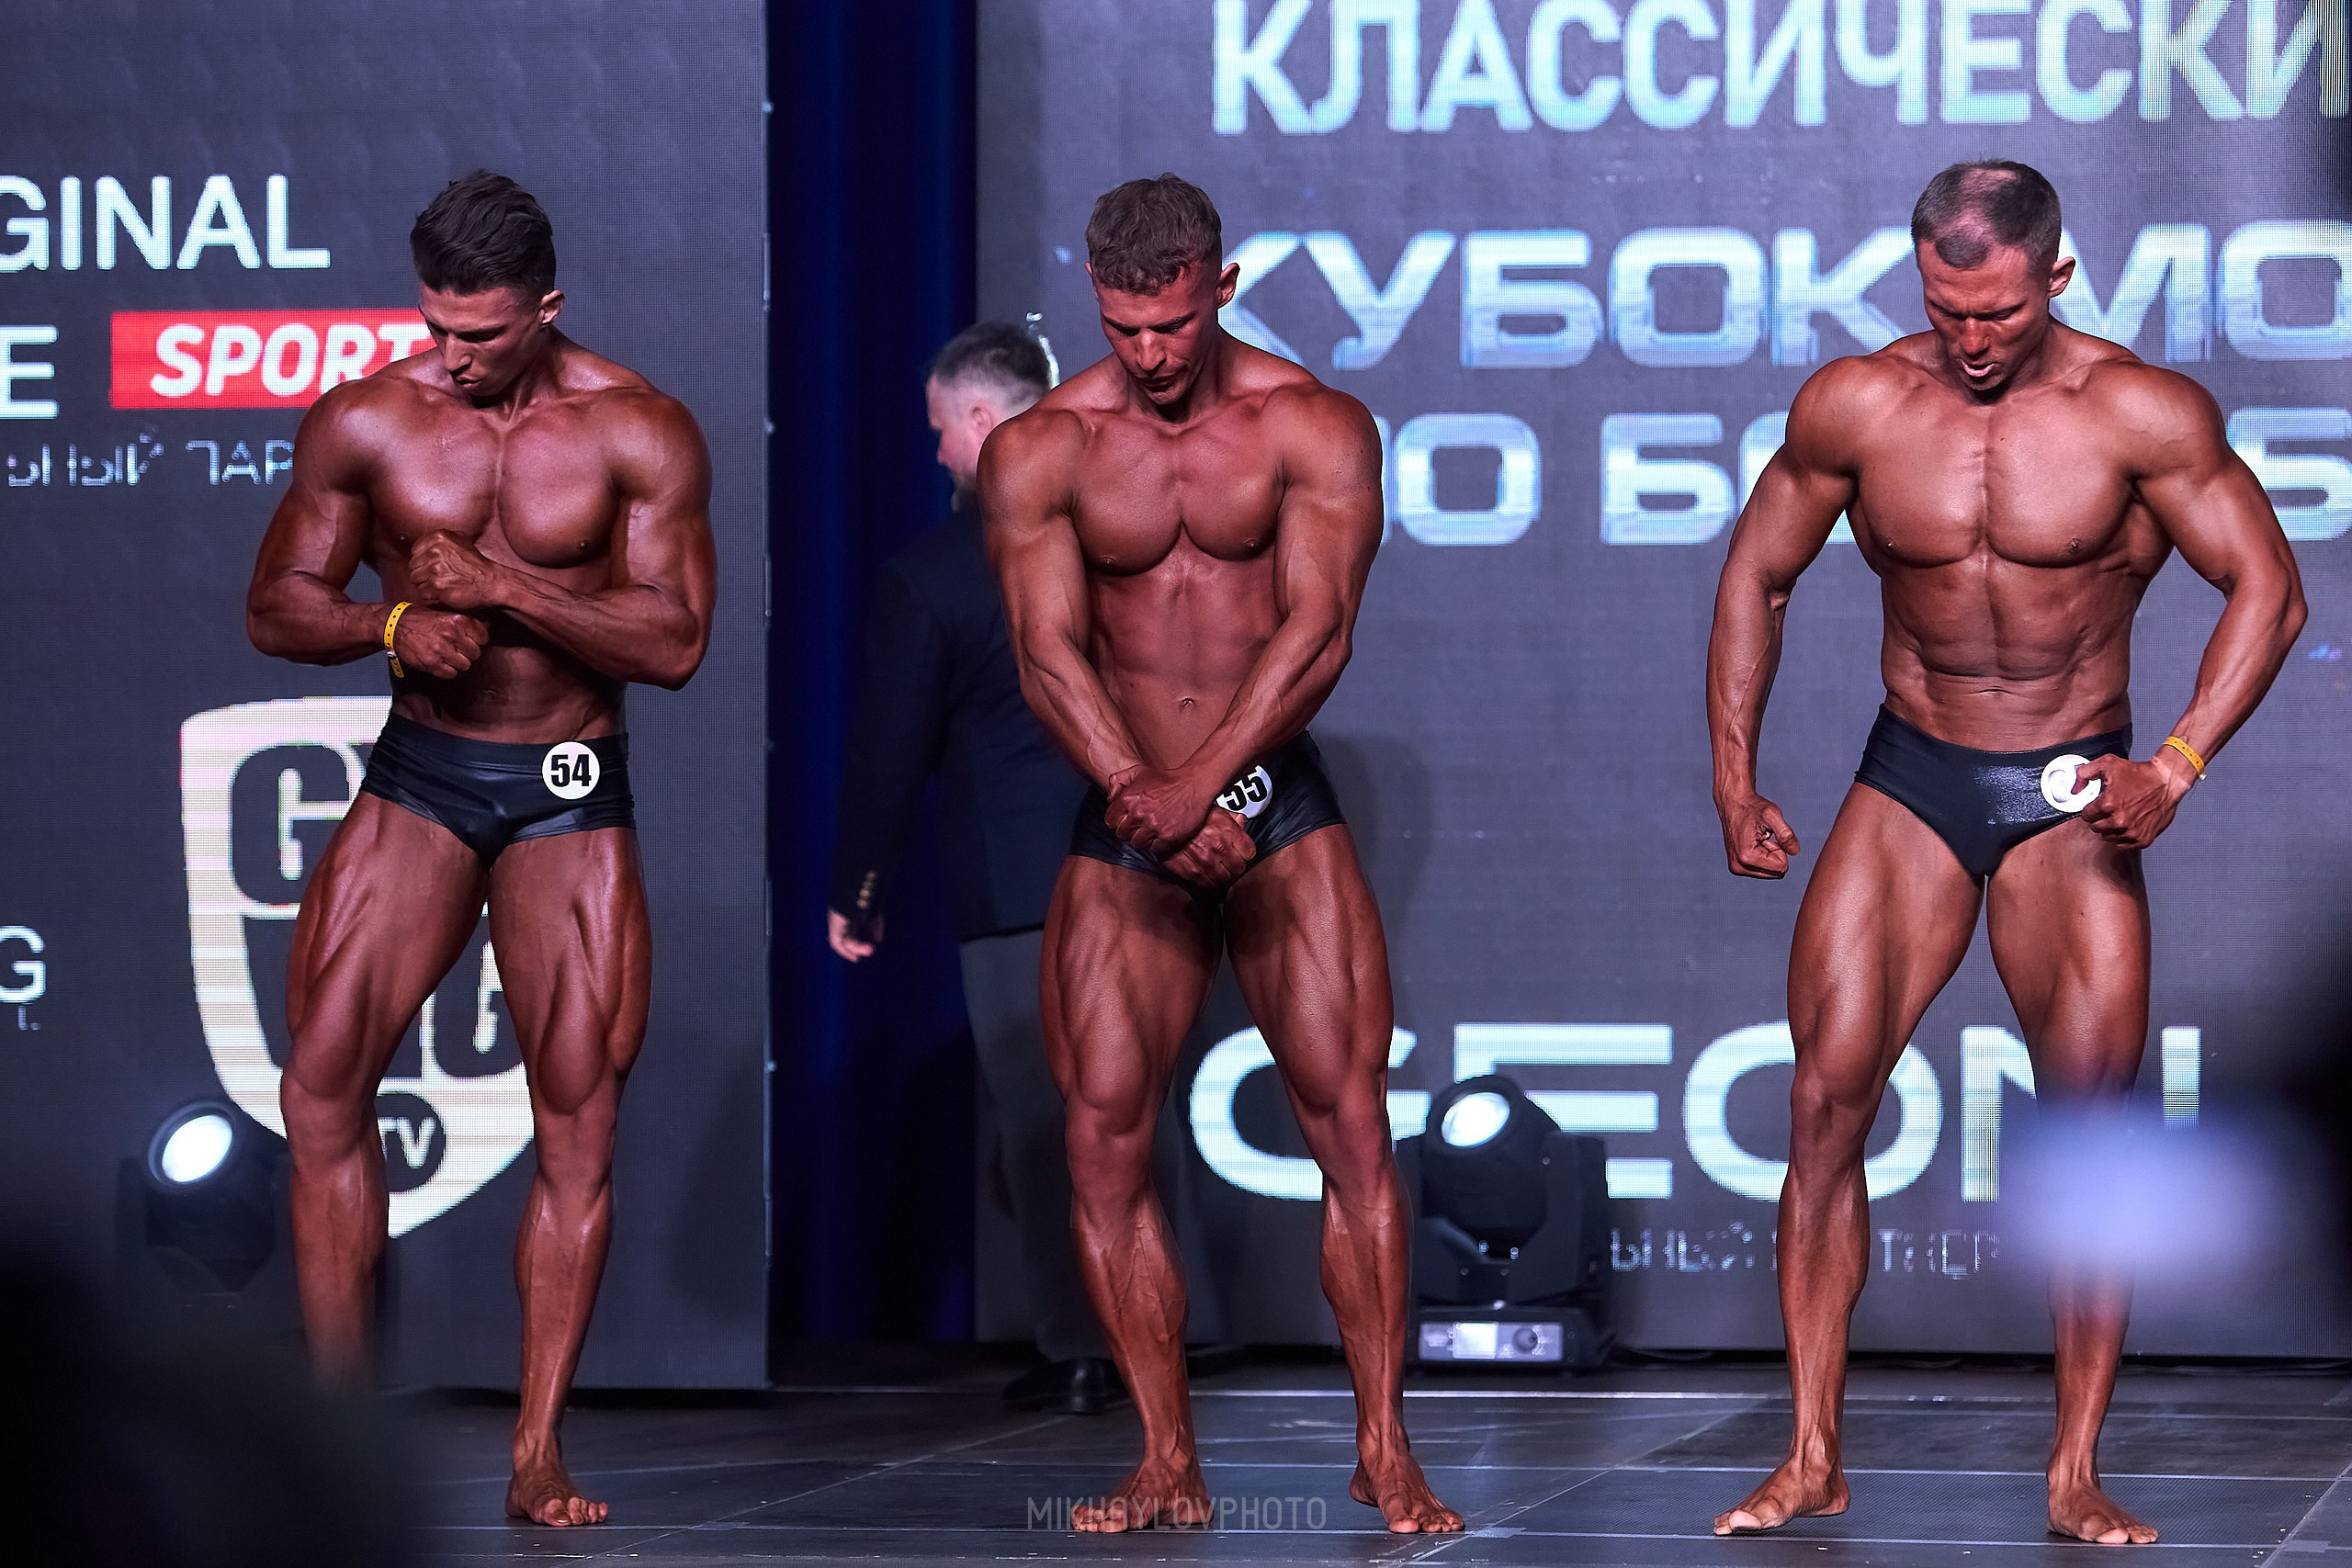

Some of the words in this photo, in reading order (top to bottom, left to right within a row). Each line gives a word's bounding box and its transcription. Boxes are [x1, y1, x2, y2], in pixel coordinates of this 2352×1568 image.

[150, 322, 433, 399] SPORT
[1374, 412, 1544, 547] О
[550, 753, 592, 787] 54
[1225, 775, 1268, 811] 55
